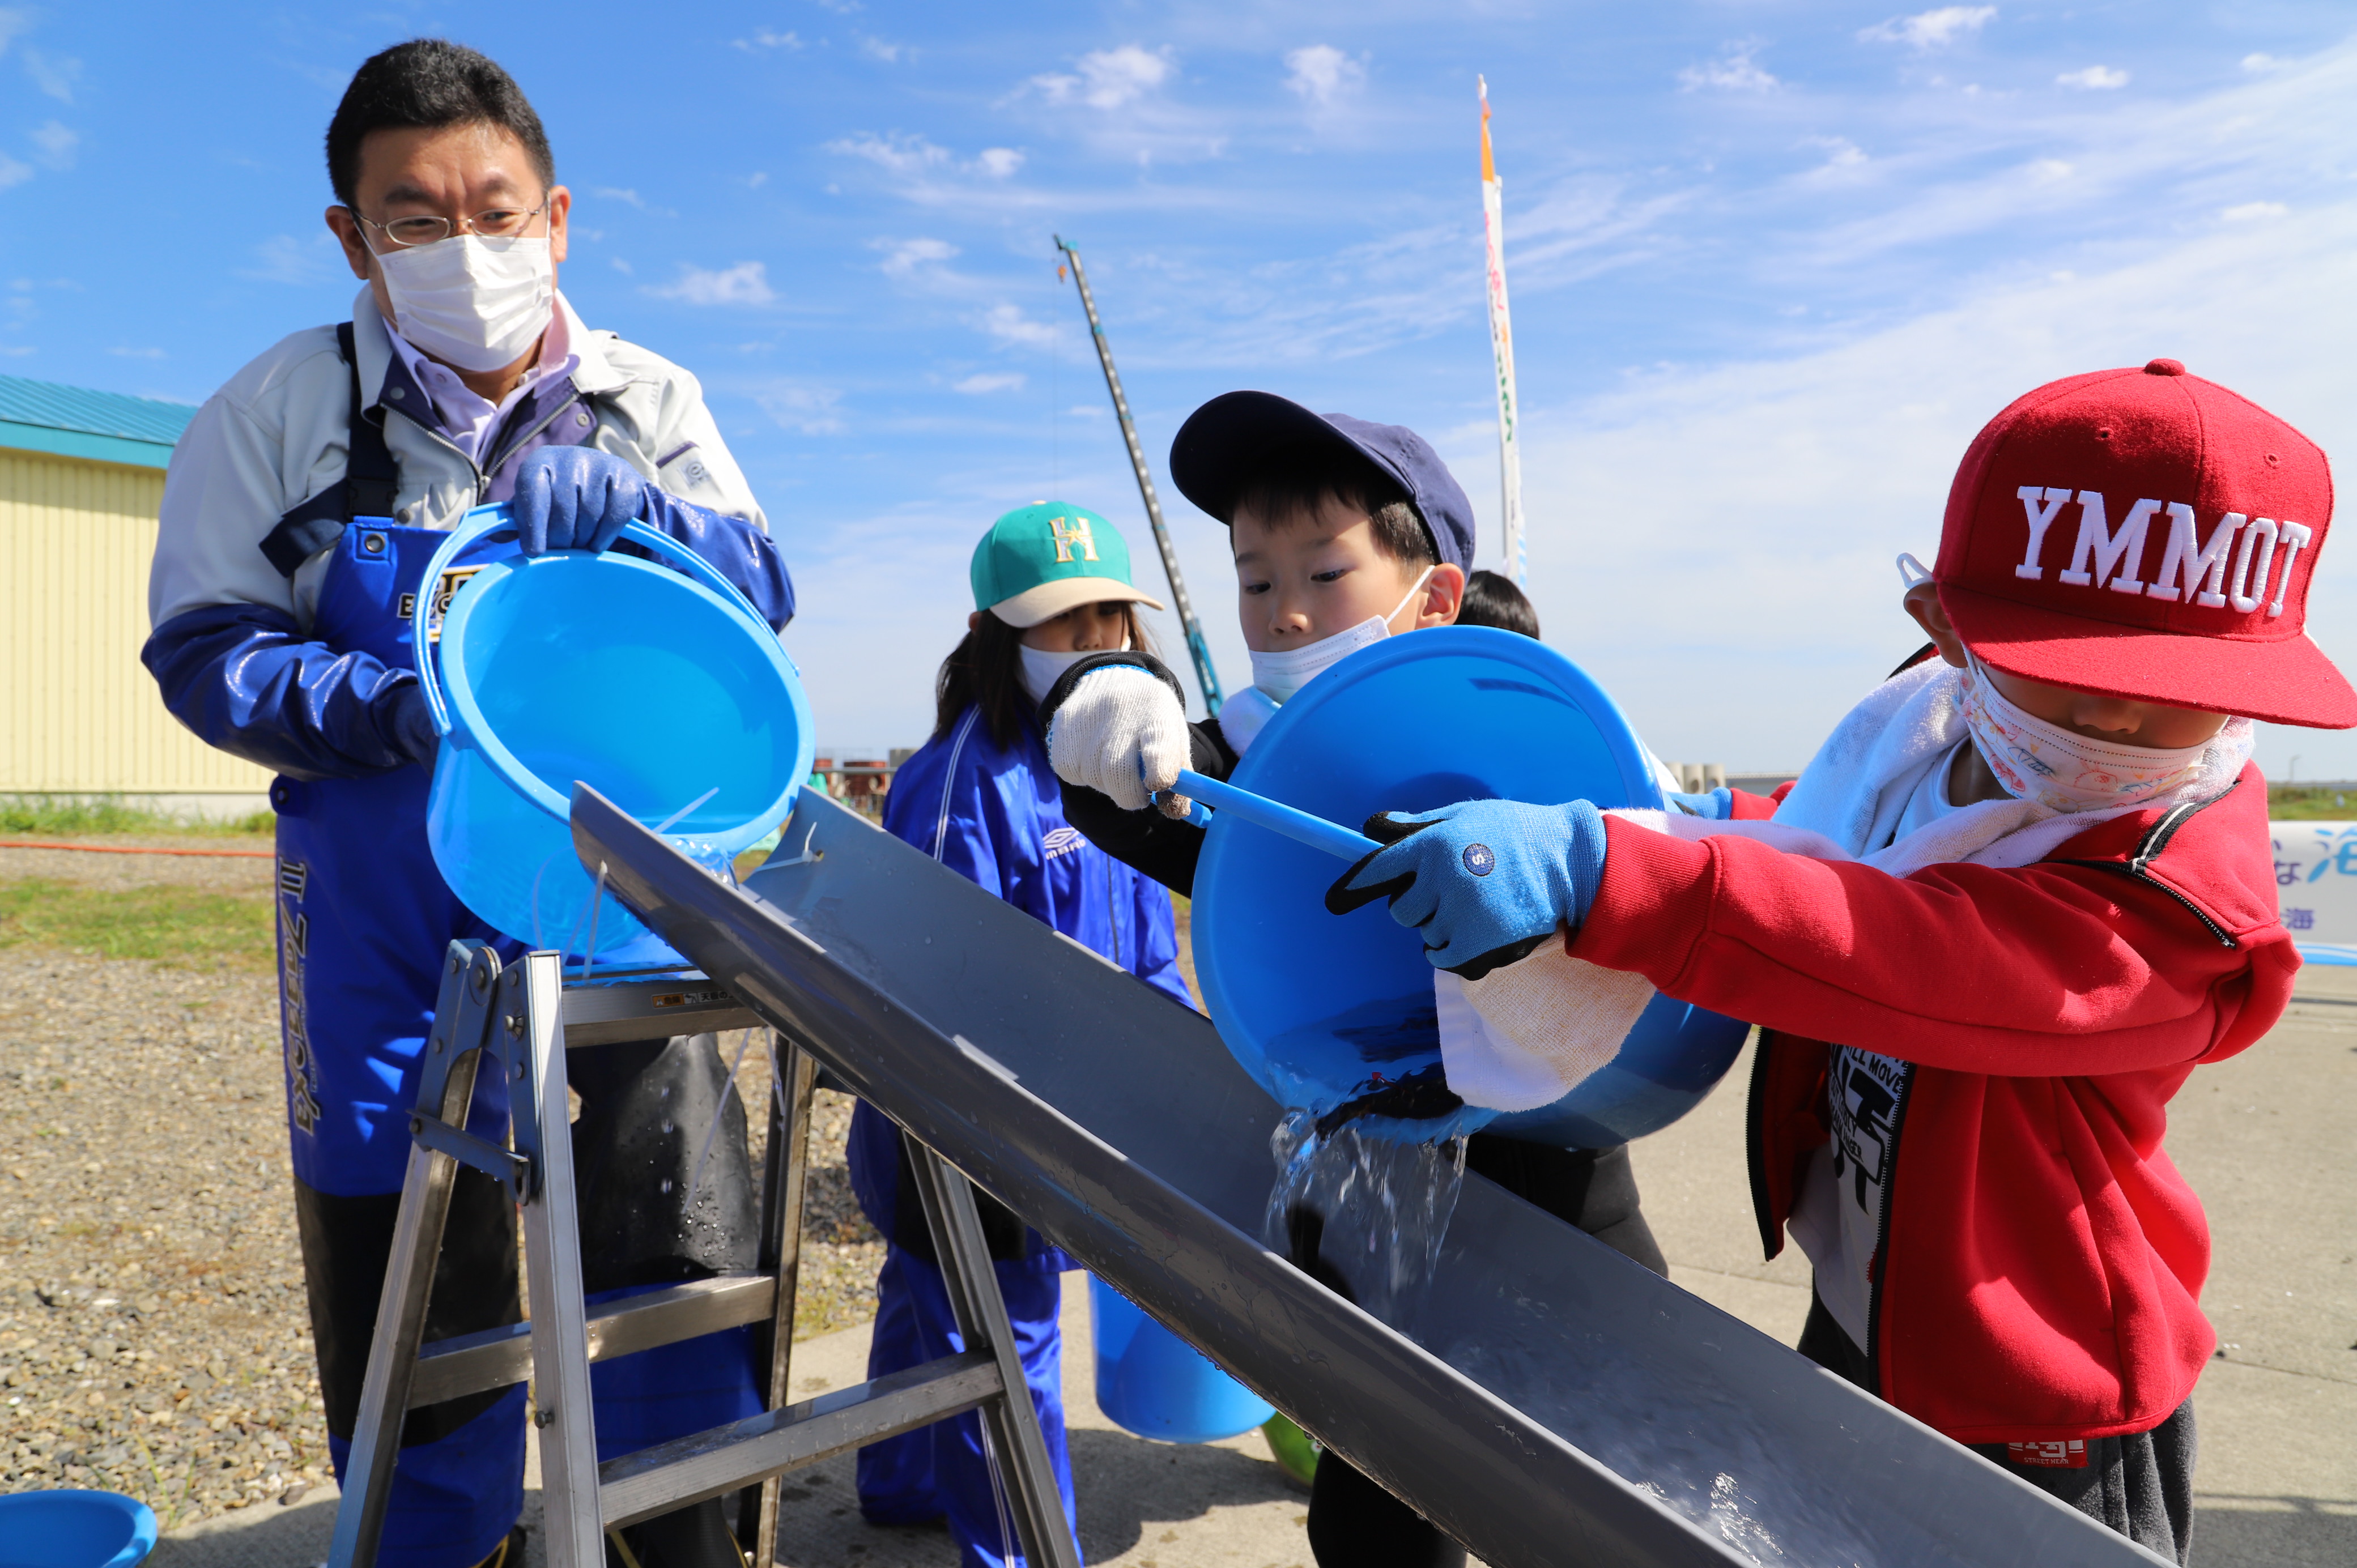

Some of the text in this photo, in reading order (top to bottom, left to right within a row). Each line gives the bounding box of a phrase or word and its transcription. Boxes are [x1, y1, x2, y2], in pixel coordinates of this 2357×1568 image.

[1049, 516, 1100, 563] H
[2015, 485, 2312, 618] YMMOT
[1471, 854, 1486, 866] S
[2280, 908, 2313, 930] 海
[701, 992, 734, 1001] 天板の
